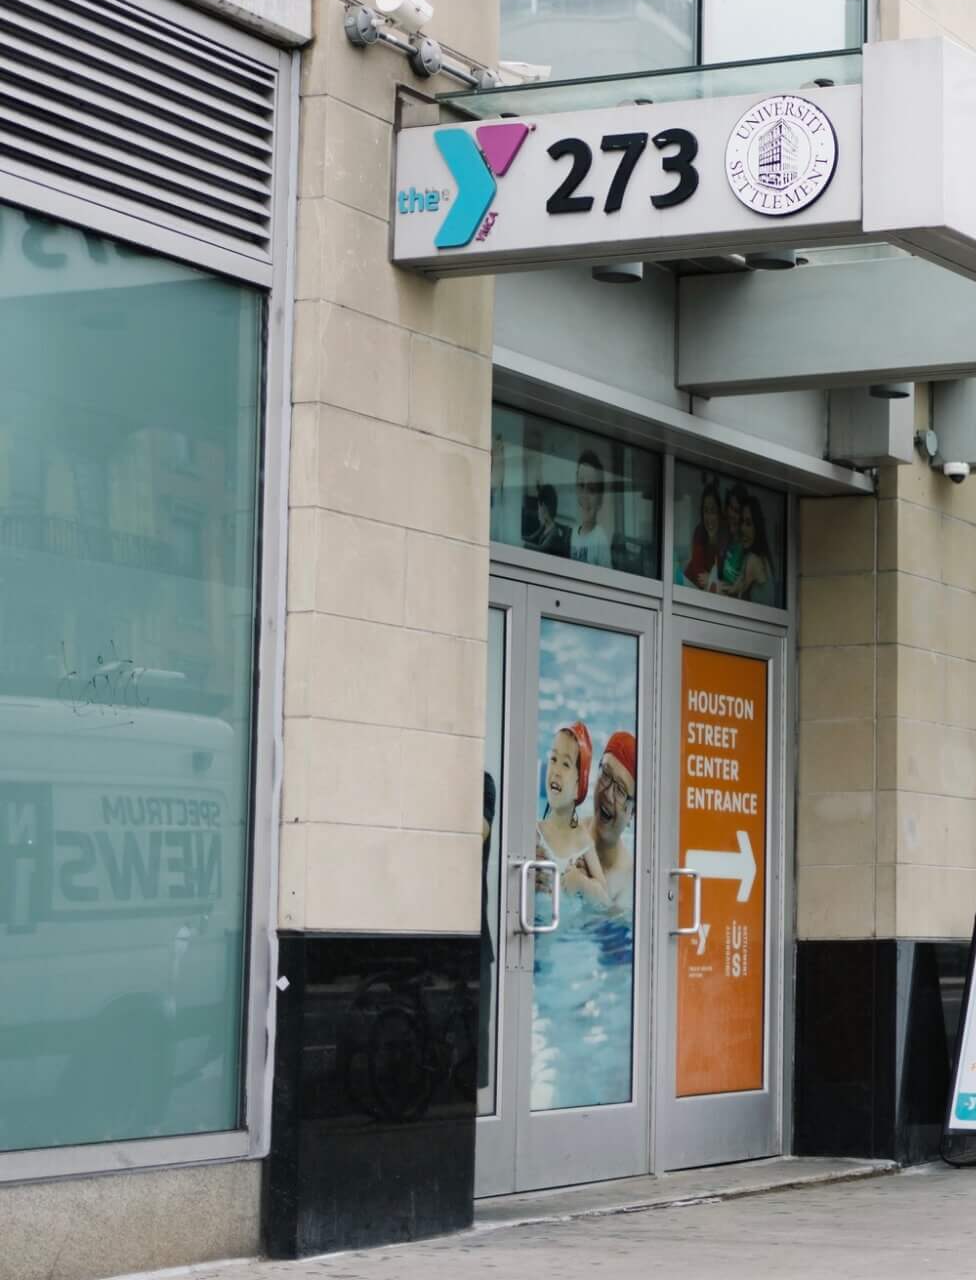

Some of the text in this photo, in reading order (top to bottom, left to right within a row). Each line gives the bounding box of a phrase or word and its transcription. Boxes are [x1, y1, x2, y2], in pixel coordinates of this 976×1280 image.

[736, 101, 826, 140] UNIVERSITY
[546, 128, 700, 214] 273
[730, 154, 828, 209] SETTLEMENT
[398, 186, 441, 214] the
[688, 689, 754, 721] HOUSTON
[687, 722, 738, 750] STREET
[687, 754, 739, 782] CENTER
[687, 786, 757, 815] ENTRANCE
